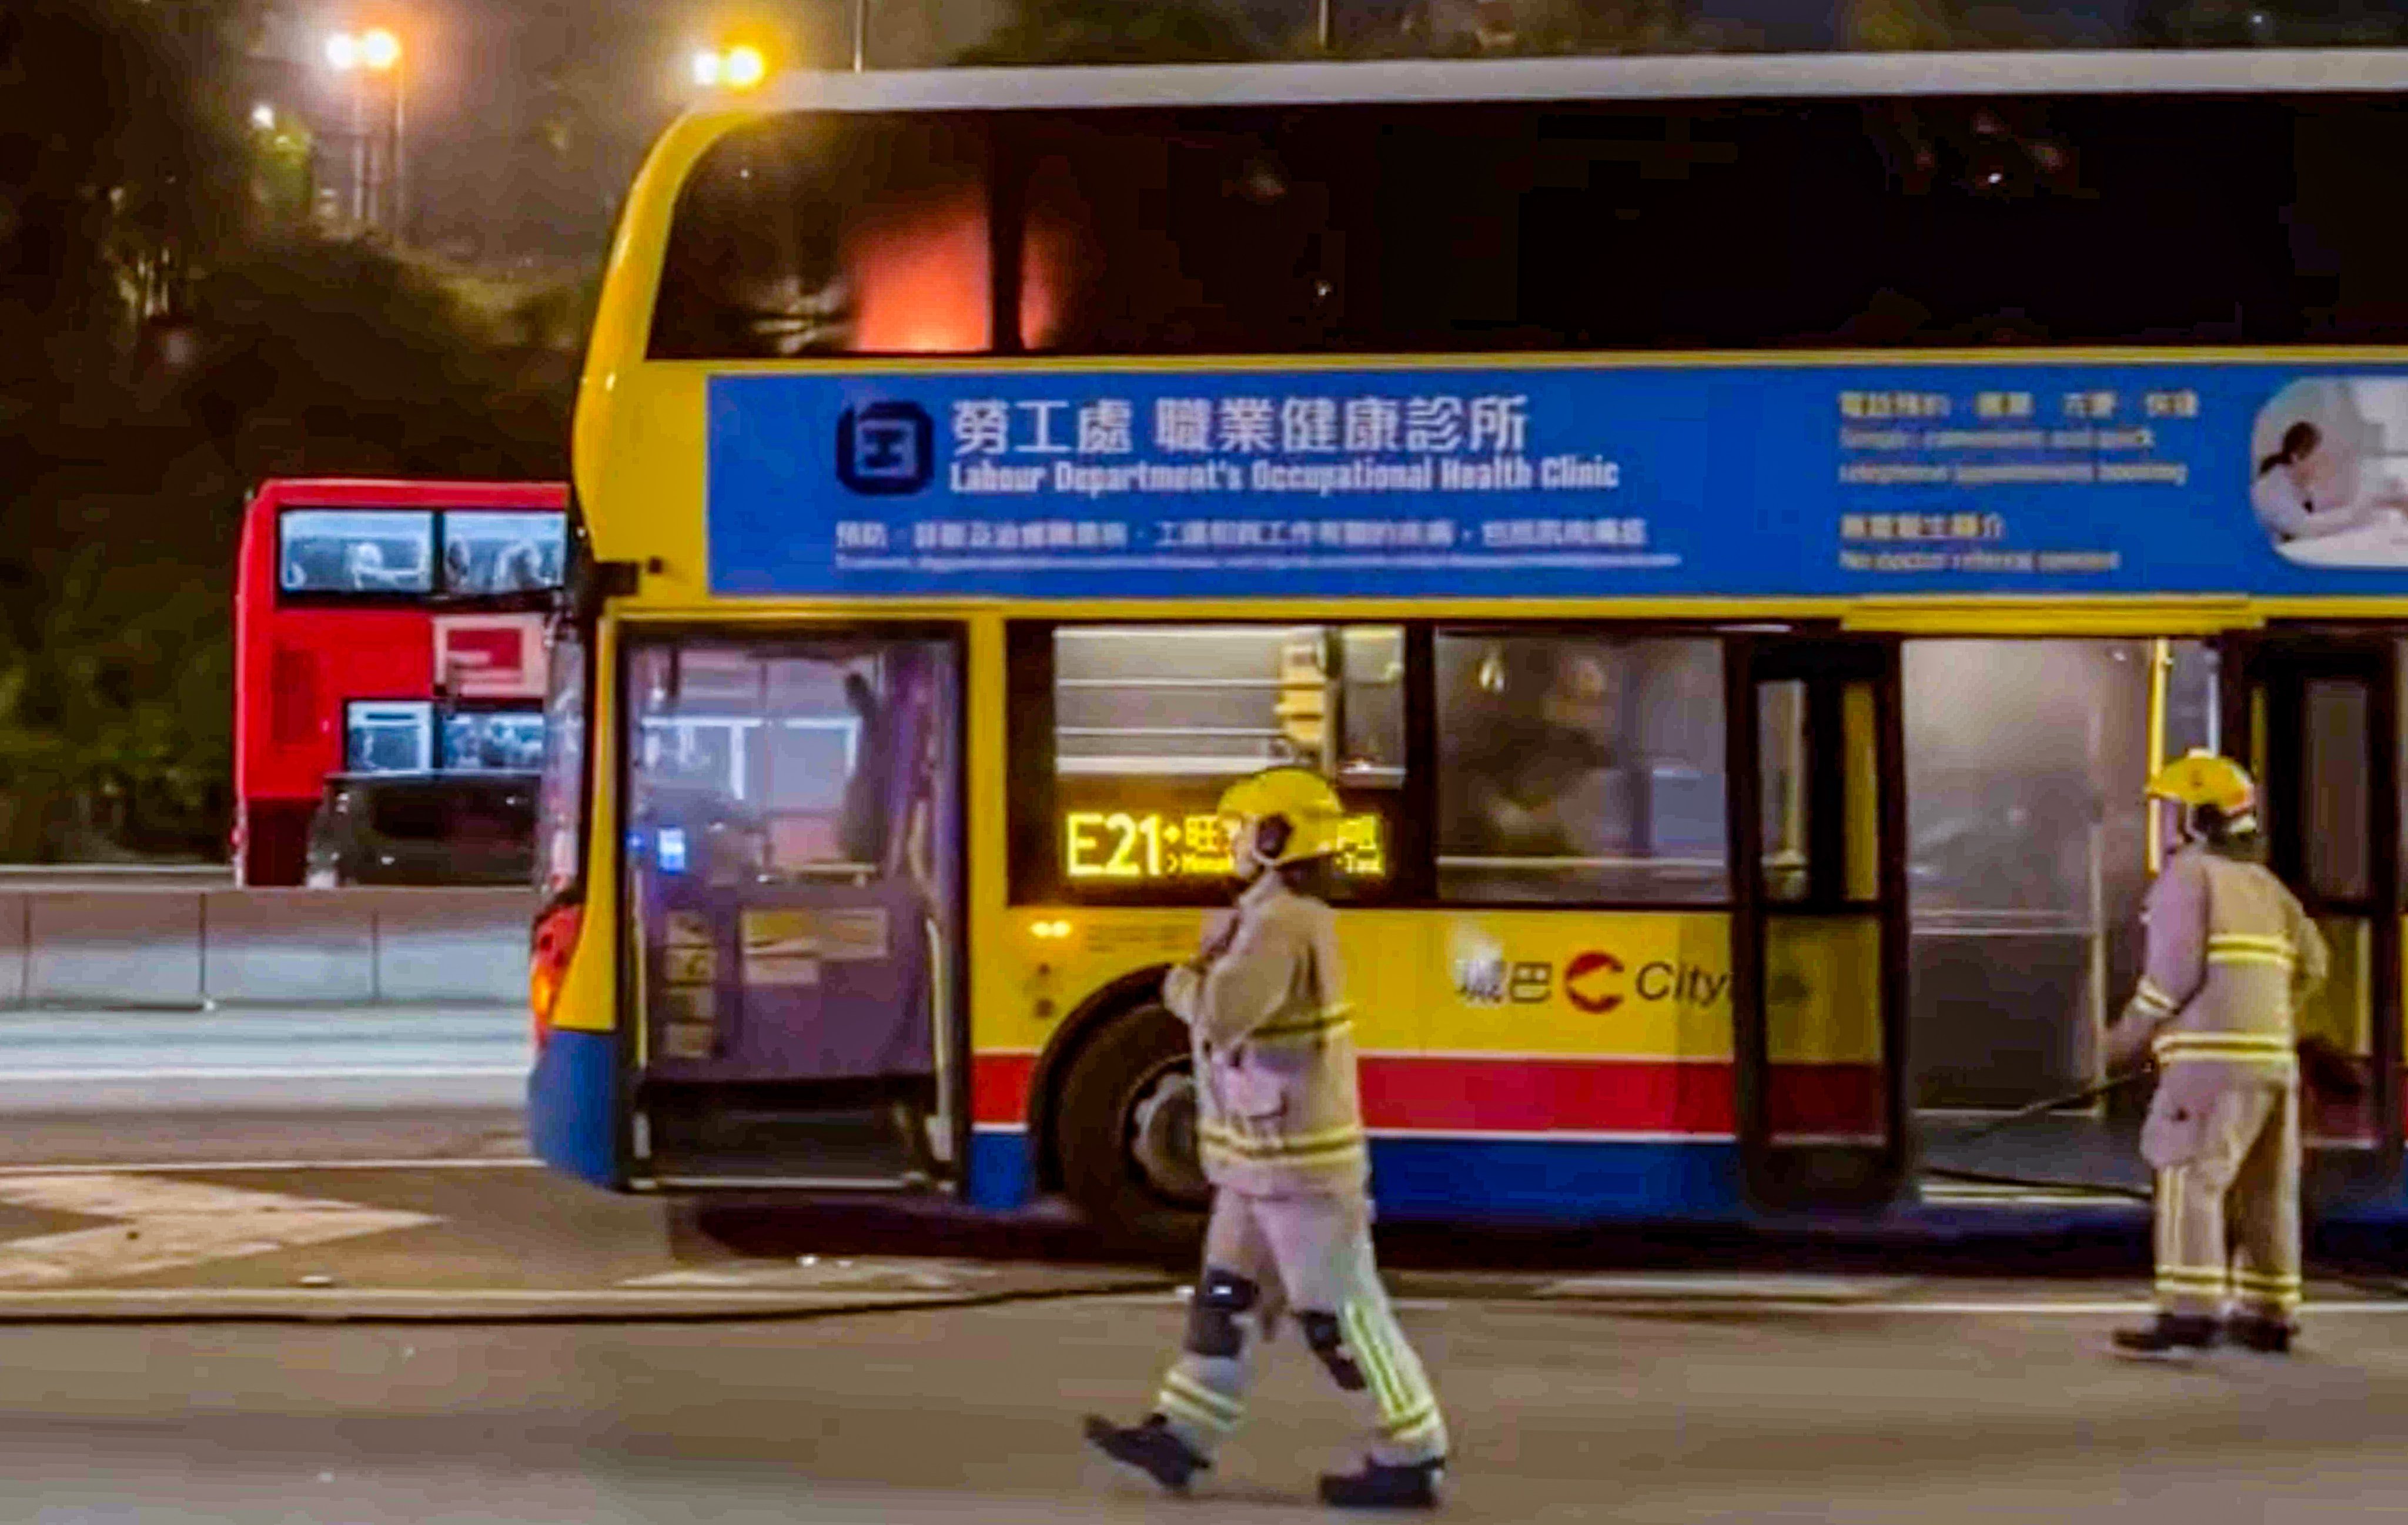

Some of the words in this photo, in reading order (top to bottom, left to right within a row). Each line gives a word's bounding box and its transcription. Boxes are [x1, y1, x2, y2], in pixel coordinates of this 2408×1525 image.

[952, 399, 1132, 456] 勞工處
[1155, 395, 1527, 453] 職業健康診所
[950, 460, 1046, 493] Labour
[1054, 459, 1243, 500] Department's
[1251, 455, 1433, 497] Occupational
[1441, 457, 1533, 489] Health
[1540, 455, 1620, 489] Clinic
[1066, 813, 1160, 877] E21
